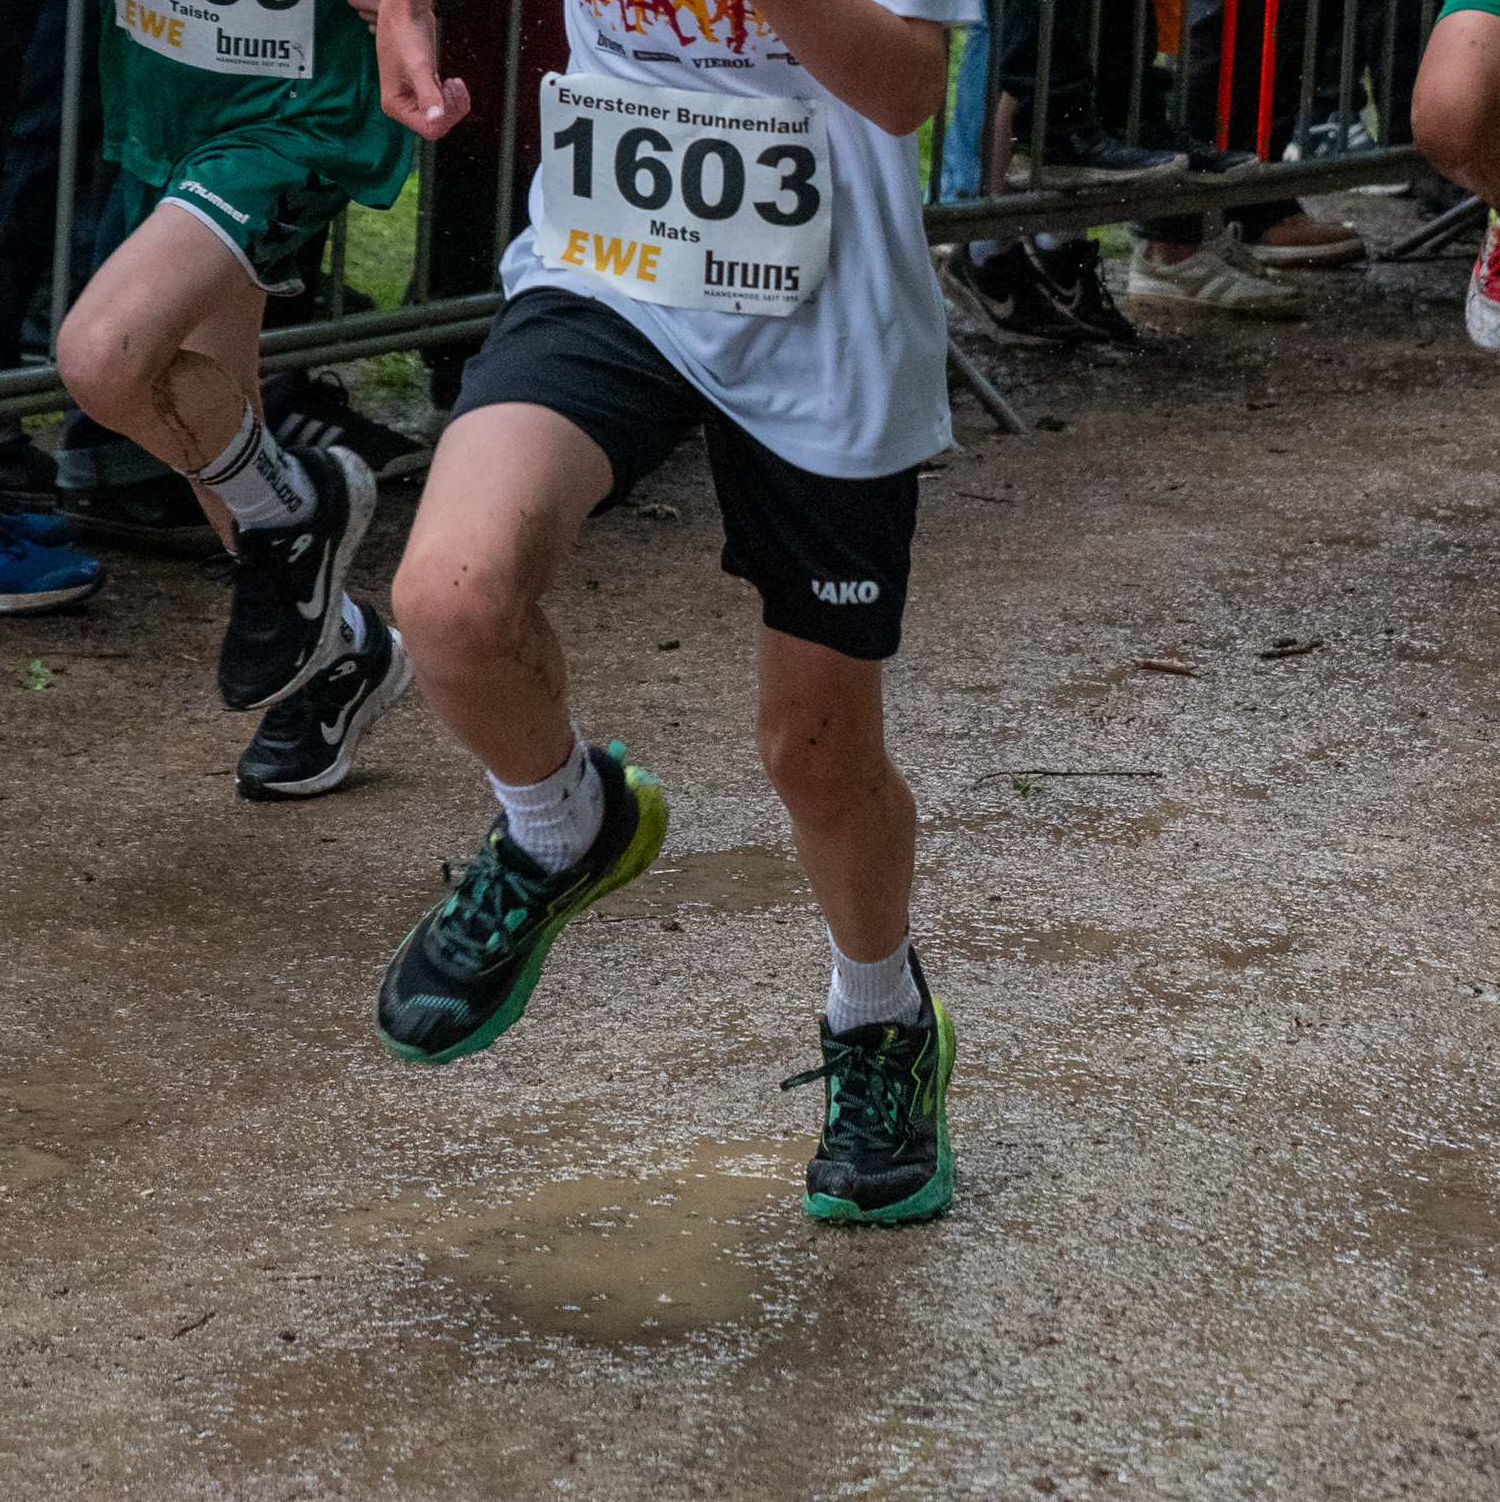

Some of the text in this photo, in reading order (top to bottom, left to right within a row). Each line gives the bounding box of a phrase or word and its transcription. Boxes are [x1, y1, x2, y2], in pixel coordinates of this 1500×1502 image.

[169, 0, 220, 23] Taisto
[217, 27, 290, 59] bruns
[691, 57, 755, 69] VIEROL
[558, 88, 810, 135] Everstener Brunnenlauf
[553, 116, 821, 227] 1603
[187, 180, 250, 225] hummel
[650, 219, 701, 243] Mats
[560, 229, 662, 283] EWE
[704, 249, 800, 291] bruns
